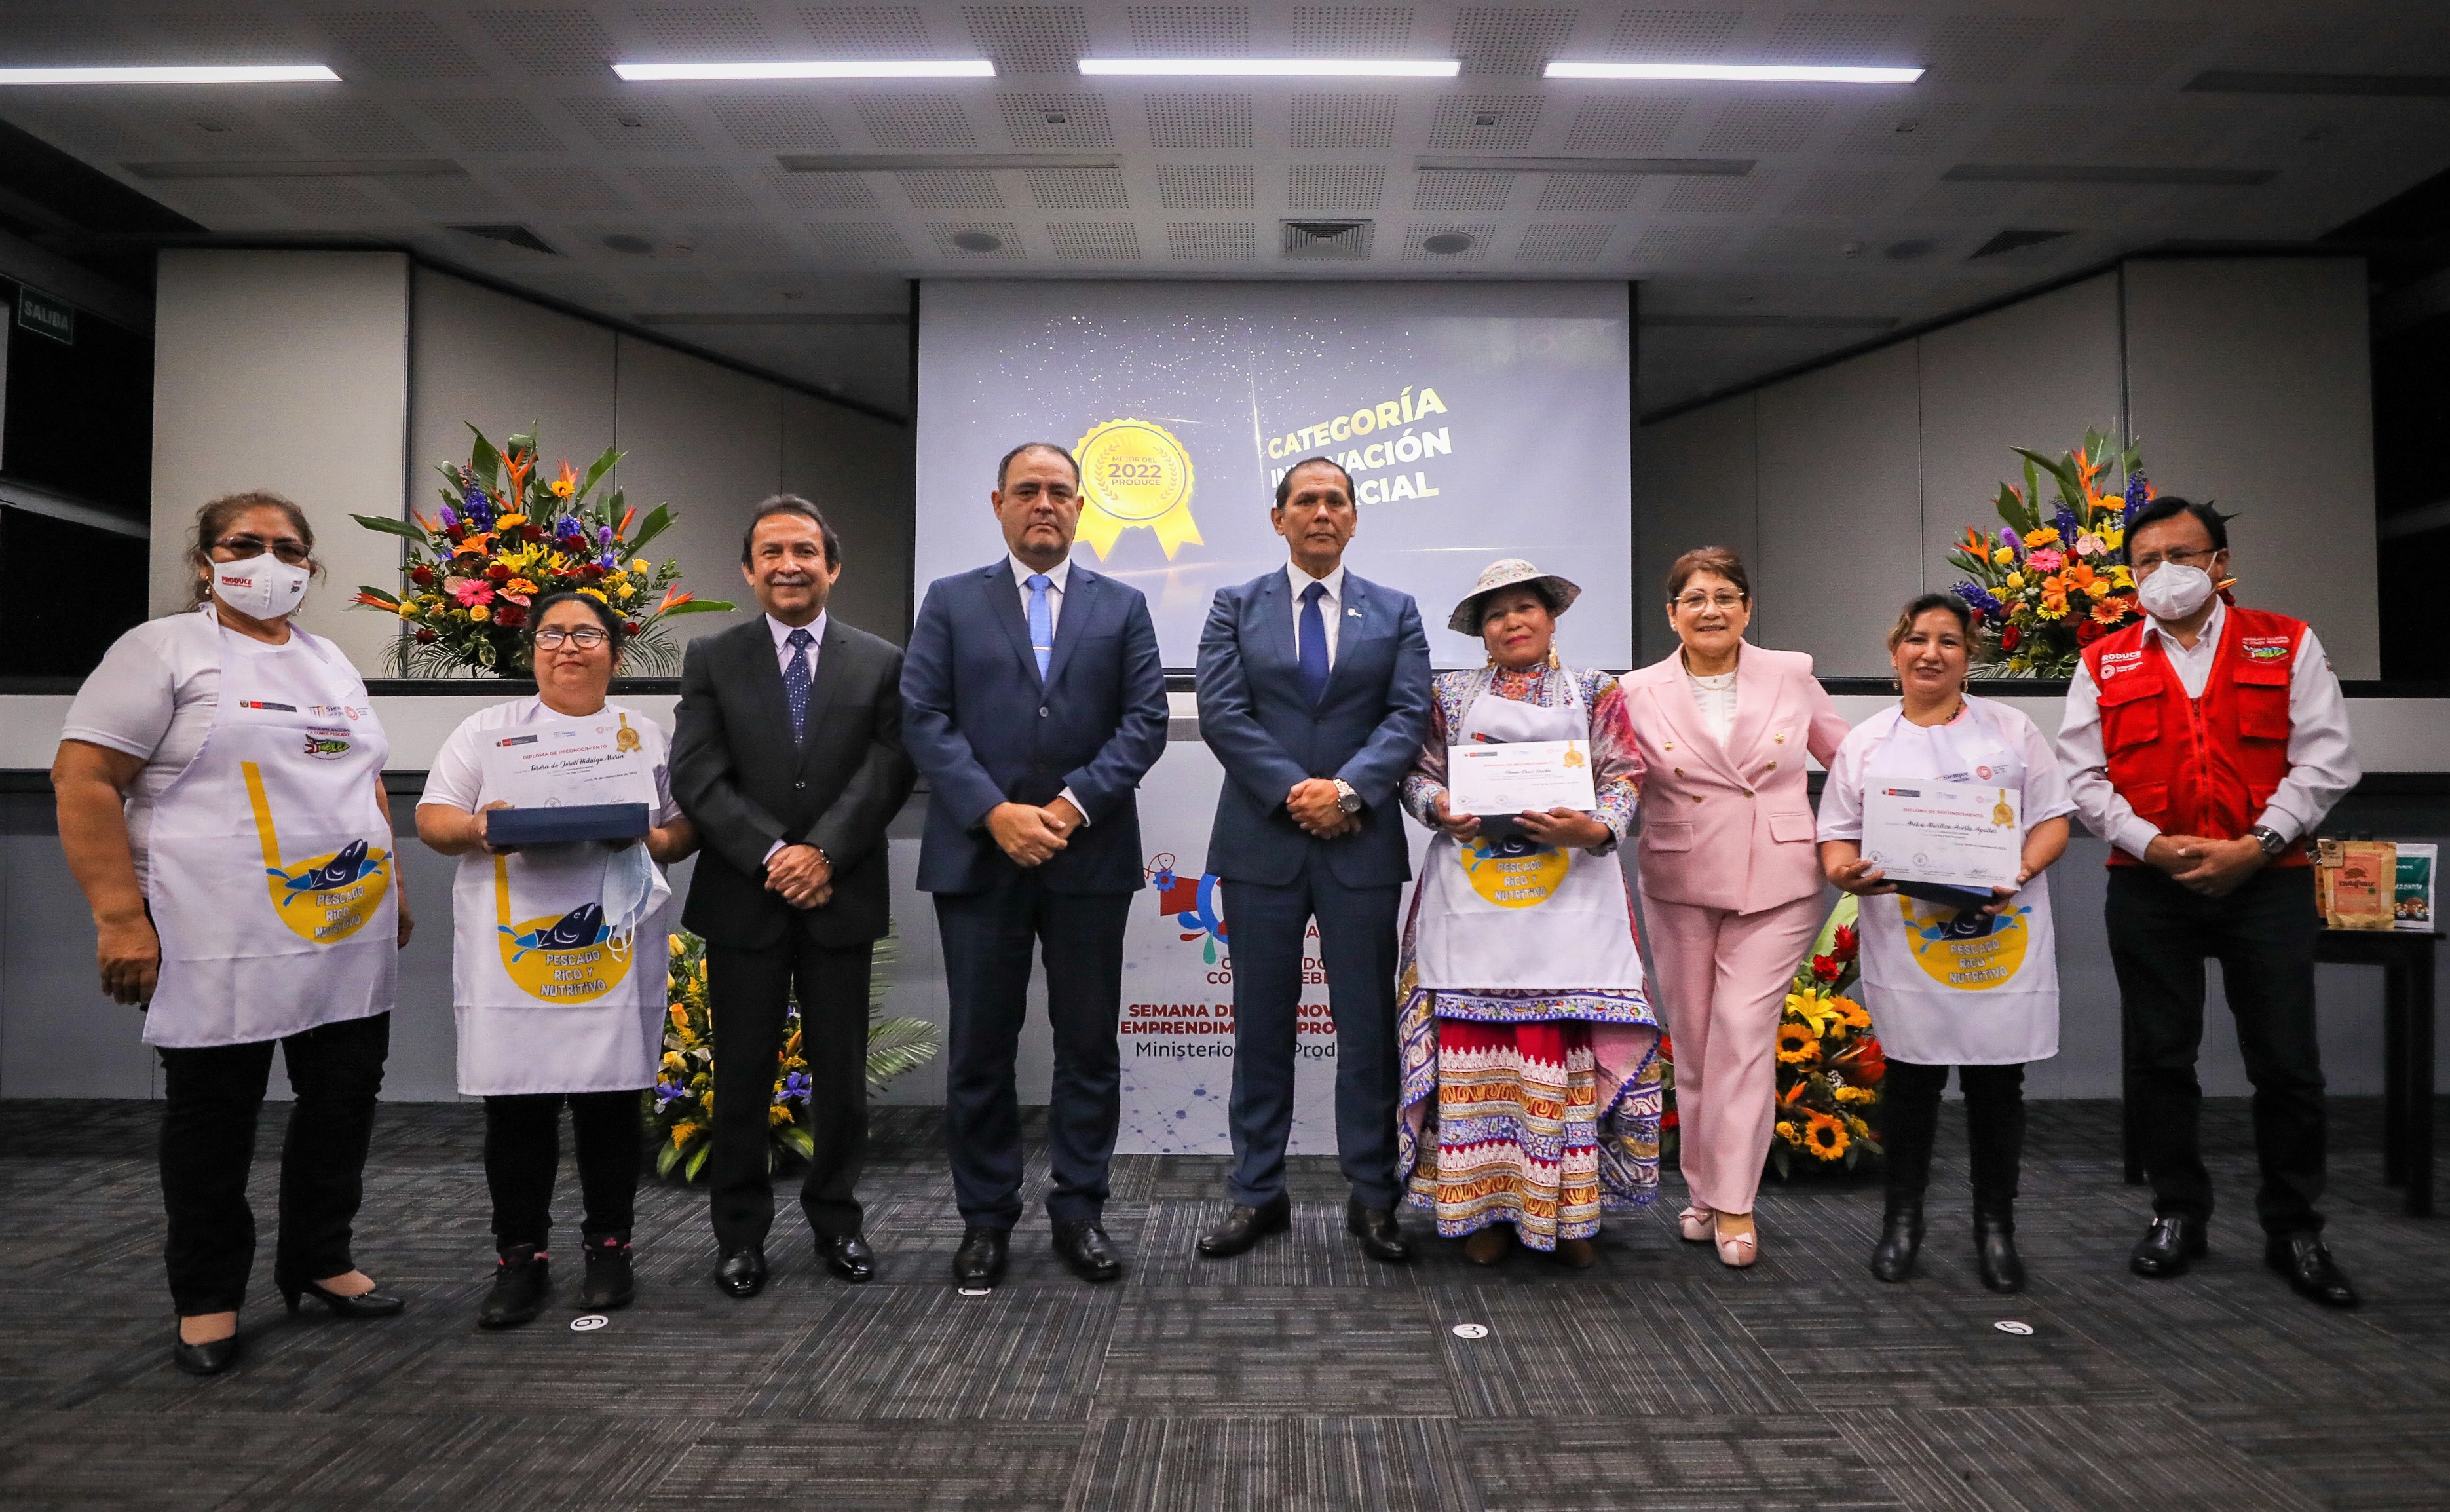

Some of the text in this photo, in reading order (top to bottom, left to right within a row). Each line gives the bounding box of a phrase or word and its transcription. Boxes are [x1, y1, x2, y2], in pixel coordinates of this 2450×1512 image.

[24, 301, 68, 331] SALIDA
[1268, 385, 1448, 459] CATEGORÍA
[1270, 426, 1452, 489] INVACIÓN
[1107, 463, 1162, 478] 2022
[222, 576, 252, 585] PRODUCE
[559, 744, 607, 755] RECONOCIMIENTO
[1497, 860, 1543, 873] PESCADO
[1532, 875, 1538, 883] Y
[316, 885, 364, 907] PESCADO
[1950, 939, 2001, 954] PESCADO
[546, 950, 601, 966] PESCADO
[1989, 955, 1994, 964] Y
[587, 966, 594, 977] Y
[1129, 1004, 1210, 1017] SEMANA
[1121, 1021, 1235, 1034] EMPRENDIM
[1136, 1040, 1234, 1057] Ministerio
[1462, 1326, 1480, 1336] 3
